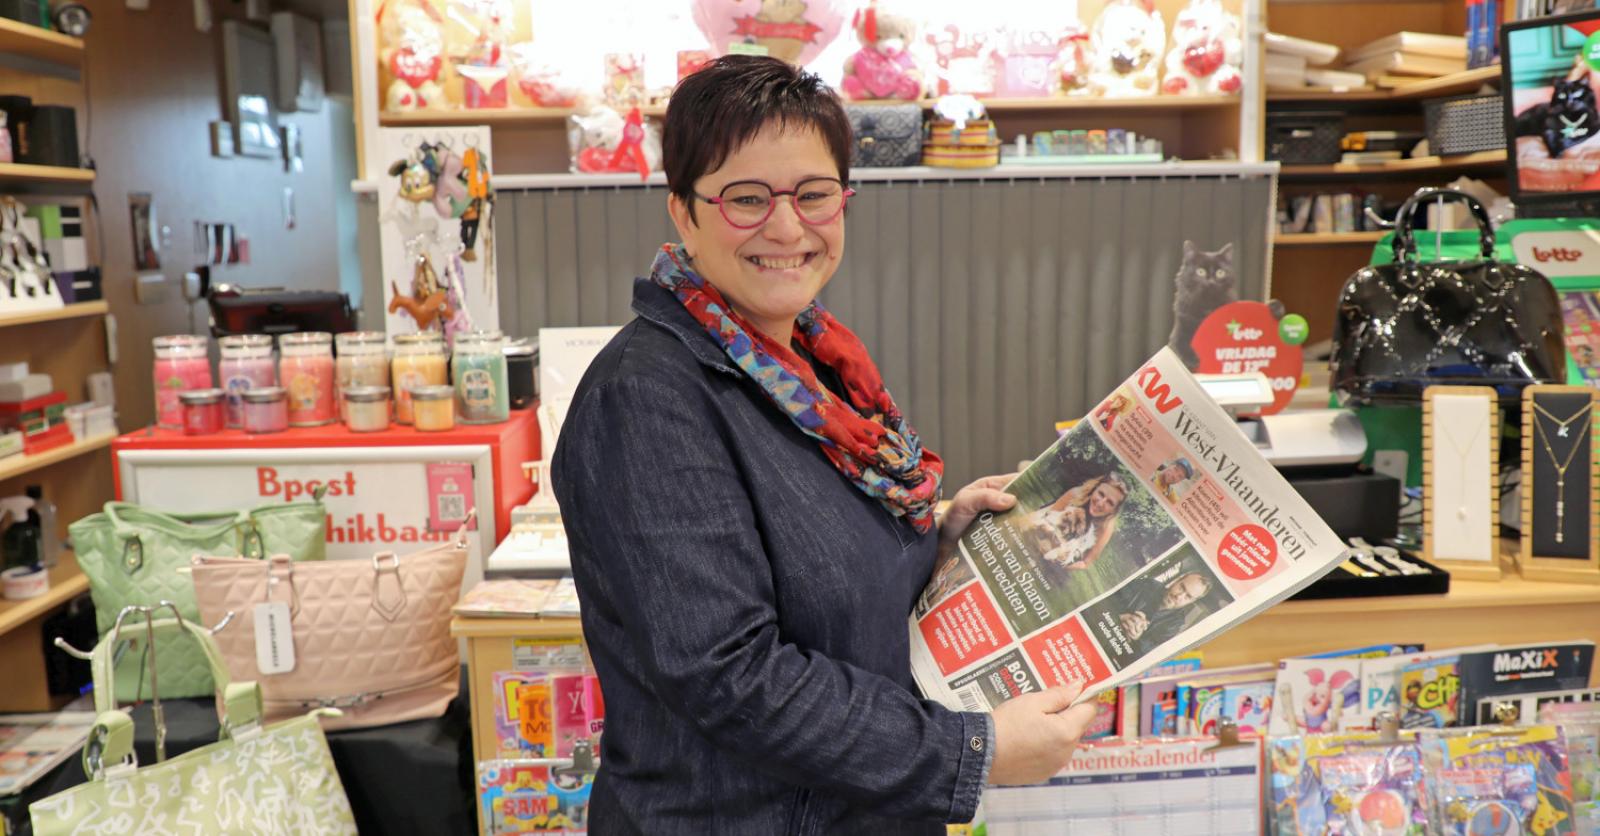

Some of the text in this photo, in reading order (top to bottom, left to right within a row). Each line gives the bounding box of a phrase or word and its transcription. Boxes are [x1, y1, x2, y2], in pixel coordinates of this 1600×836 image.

[1216, 346, 1277, 361] VRIJDAG
[256, 466, 357, 502] Bpost
[1174, 409, 1308, 563] West-Vlaanderen
[325, 513, 450, 544] hikbaar
[1221, 548, 1253, 575] gemeente
[1238, 550, 1257, 567] jouw
[1246, 546, 1270, 566] nieuws
[1256, 542, 1270, 555] nog
[970, 527, 1026, 615] blijven vechten
[979, 512, 1050, 620] Ouders van Sharon
[1098, 621, 1111, 638] oude
[1109, 637, 1122, 655] liefde
[1102, 611, 1133, 653] Jens kiest voor
[1493, 648, 1559, 673] MaXiX
[1007, 661, 1033, 694] BON
